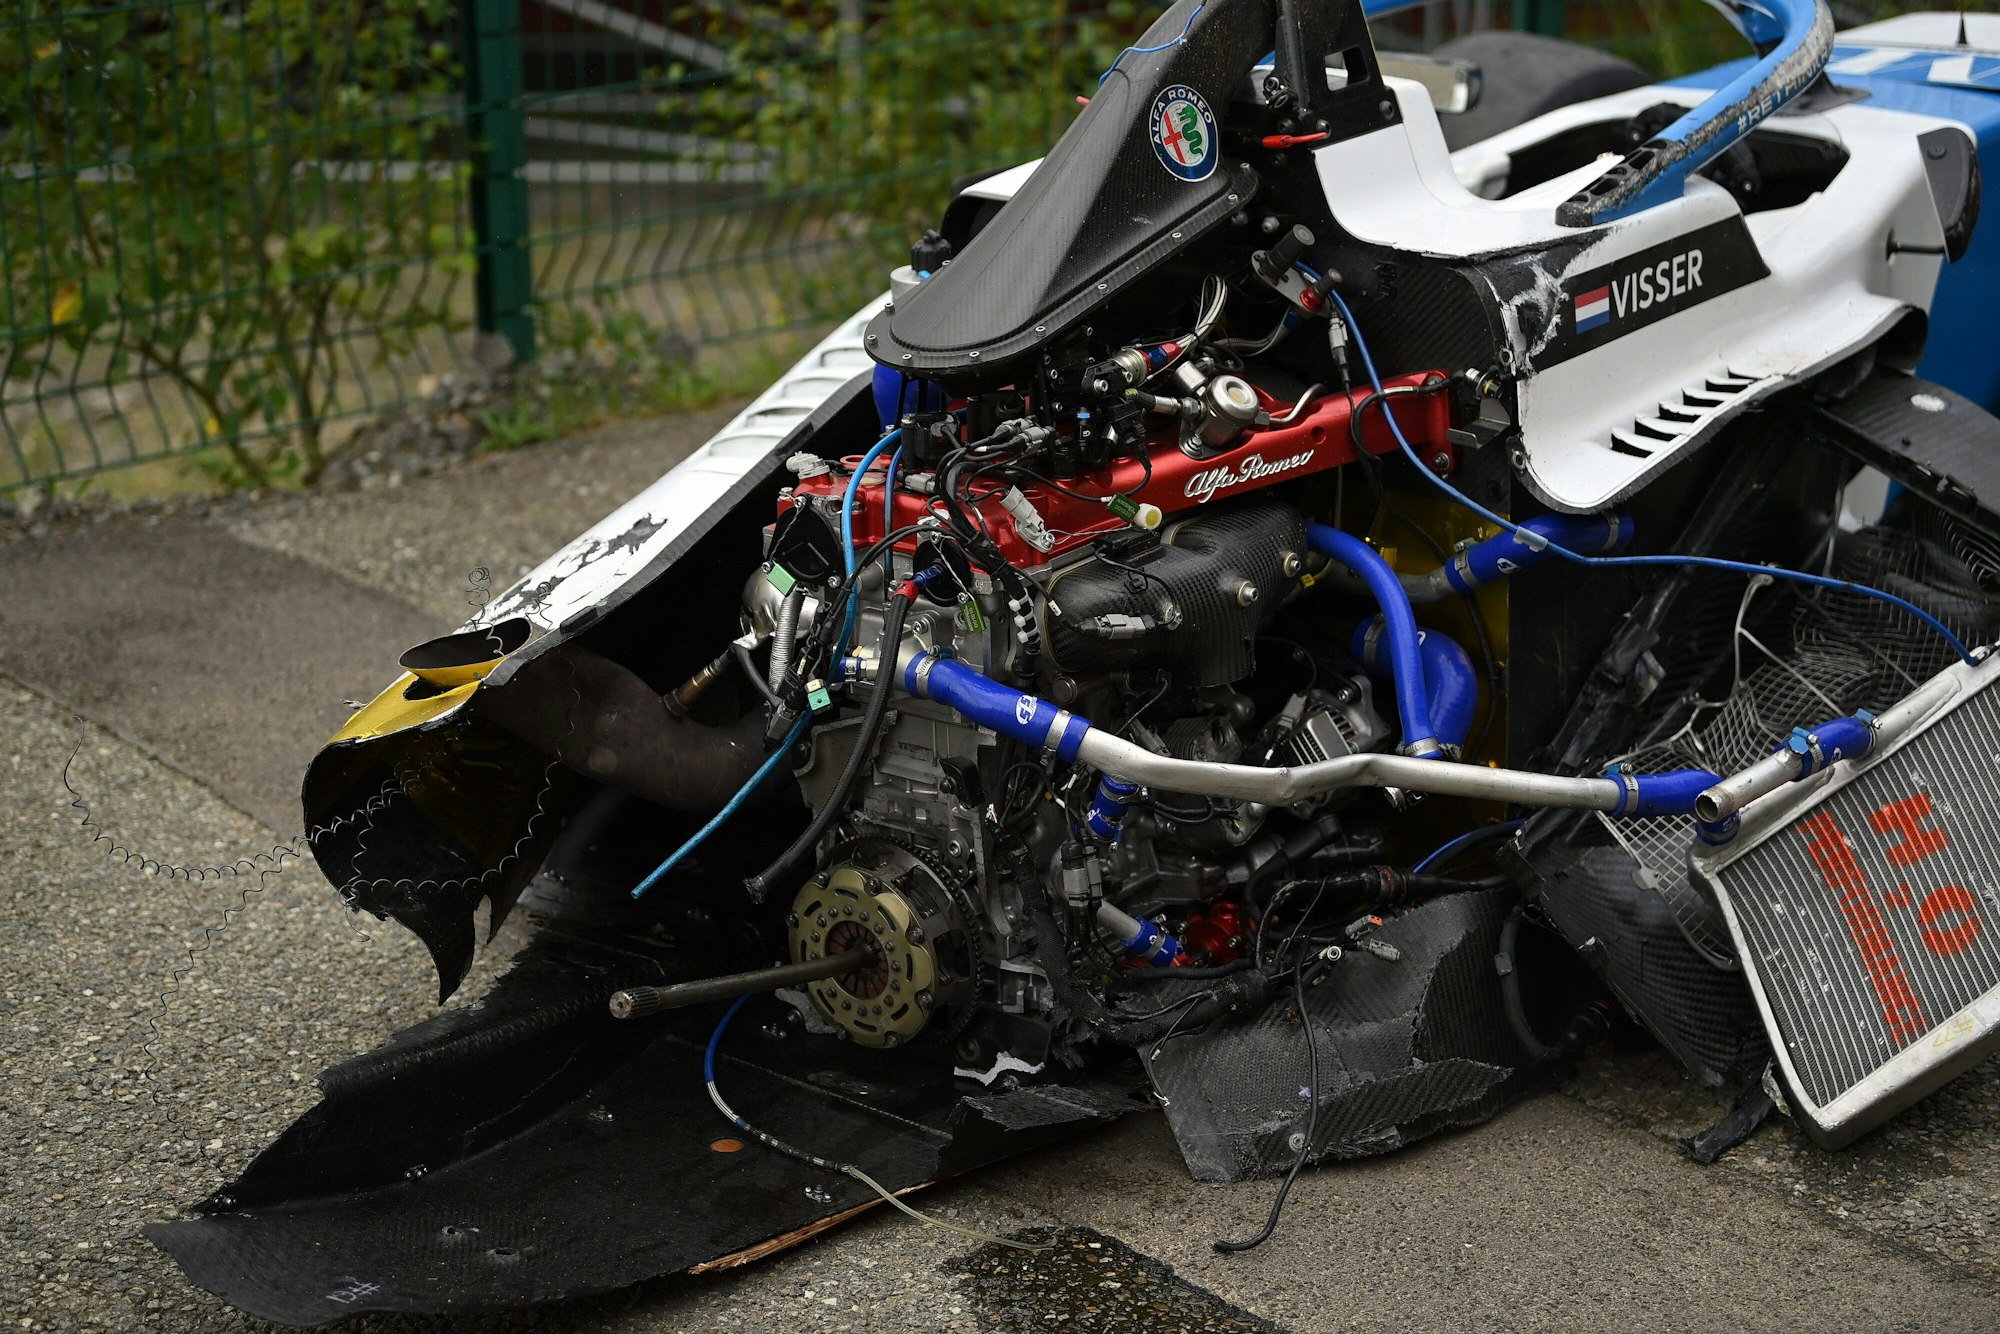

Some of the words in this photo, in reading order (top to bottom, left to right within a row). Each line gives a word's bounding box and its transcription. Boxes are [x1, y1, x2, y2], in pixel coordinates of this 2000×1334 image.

[1152, 101, 1165, 144] ALFA
[1167, 88, 1212, 123] ROMEO
[1611, 249, 1703, 318] VISSER
[1184, 465, 1239, 503] Alfa
[1239, 449, 1315, 482] Romeo
[1797, 810, 1927, 1046] PERFORMANCE
